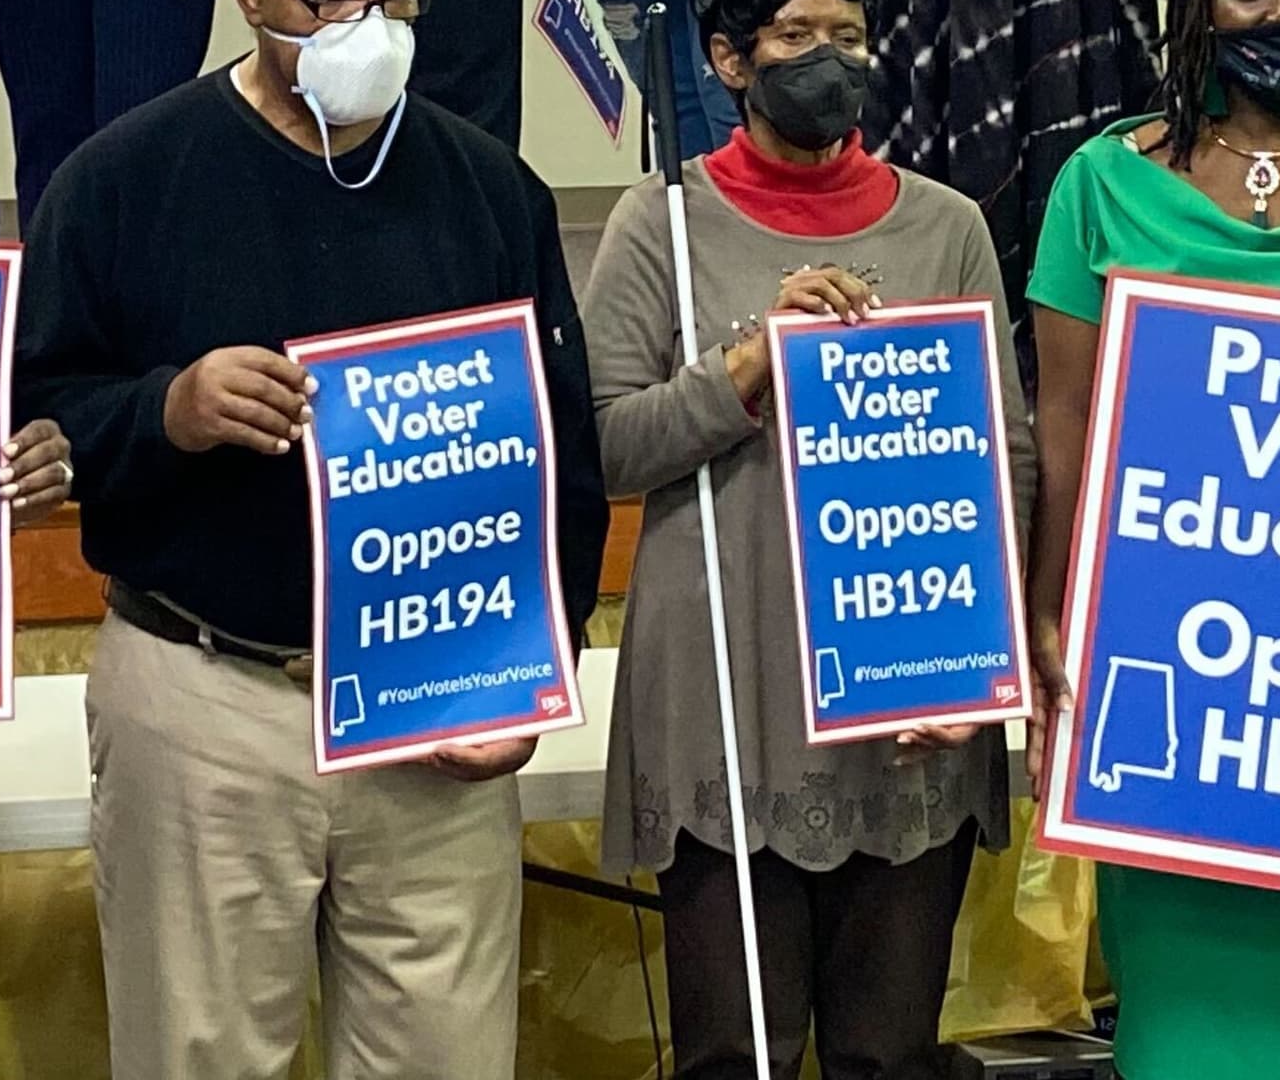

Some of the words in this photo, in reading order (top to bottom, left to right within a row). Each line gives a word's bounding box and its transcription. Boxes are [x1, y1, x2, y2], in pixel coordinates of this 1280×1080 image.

[345, 349, 494, 408] Protect
[820, 338, 952, 381] Protect
[366, 400, 484, 445] Voter
[836, 382, 939, 420] Voter
[326, 435, 538, 499] Education,
[796, 418, 990, 466] Education,
[351, 509, 522, 576] Oppose
[818, 497, 978, 550] Oppose
[359, 575, 515, 649] HB194
[832, 563, 977, 622] HB194
[378, 660, 553, 706] #YourVoteIsYourVoice
[854, 651, 1009, 683] #YourVoteIsYourVoice
